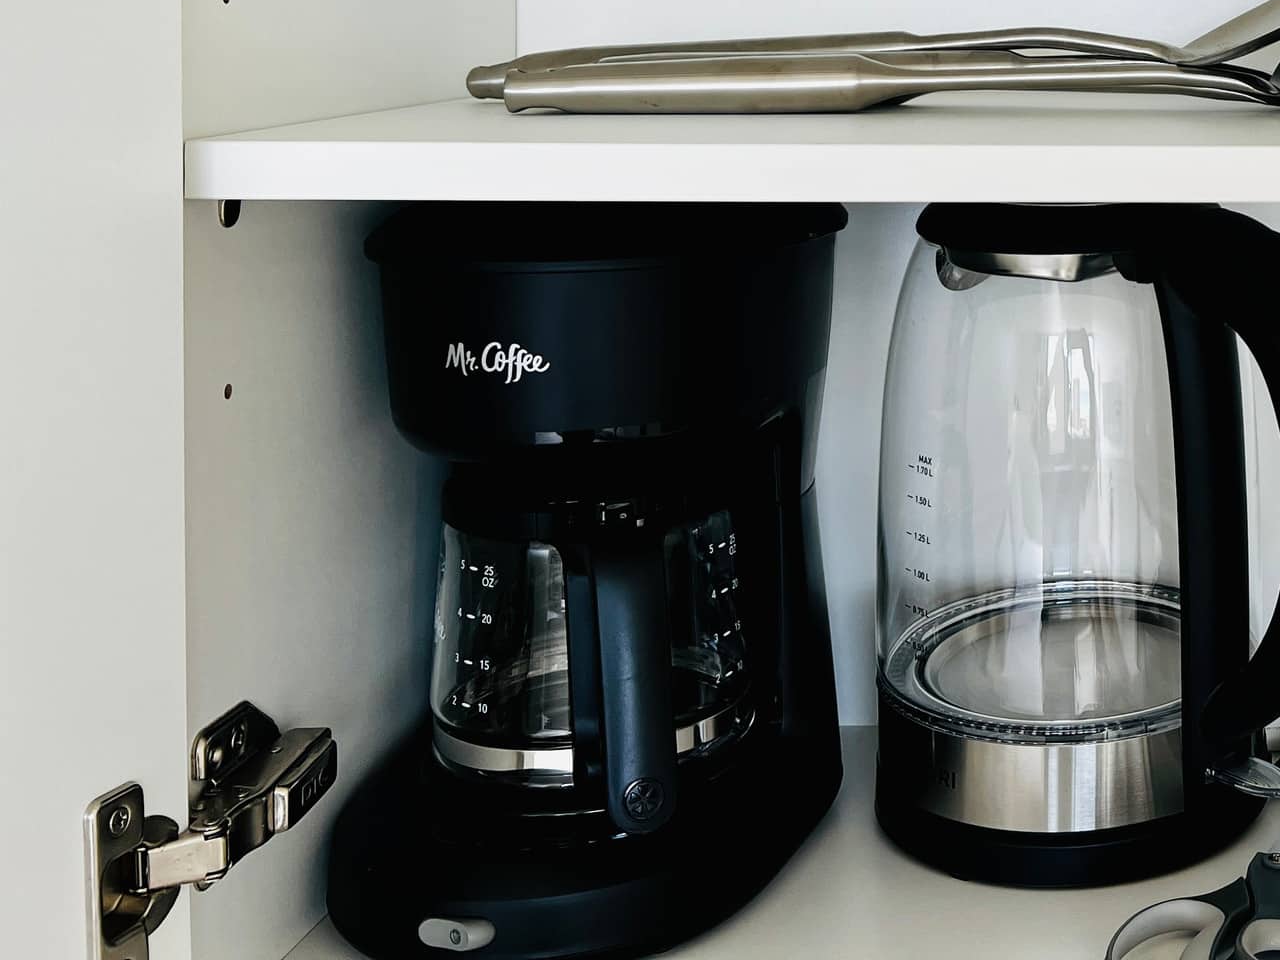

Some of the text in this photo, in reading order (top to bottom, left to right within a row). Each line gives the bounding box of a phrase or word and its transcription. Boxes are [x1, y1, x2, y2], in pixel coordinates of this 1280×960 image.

[445, 341, 551, 384] Mr. Coffee
[460, 559, 495, 577] 5 25
[457, 607, 493, 625] 4 20
[454, 652, 491, 671] 3 15
[452, 695, 489, 714] 2 10
